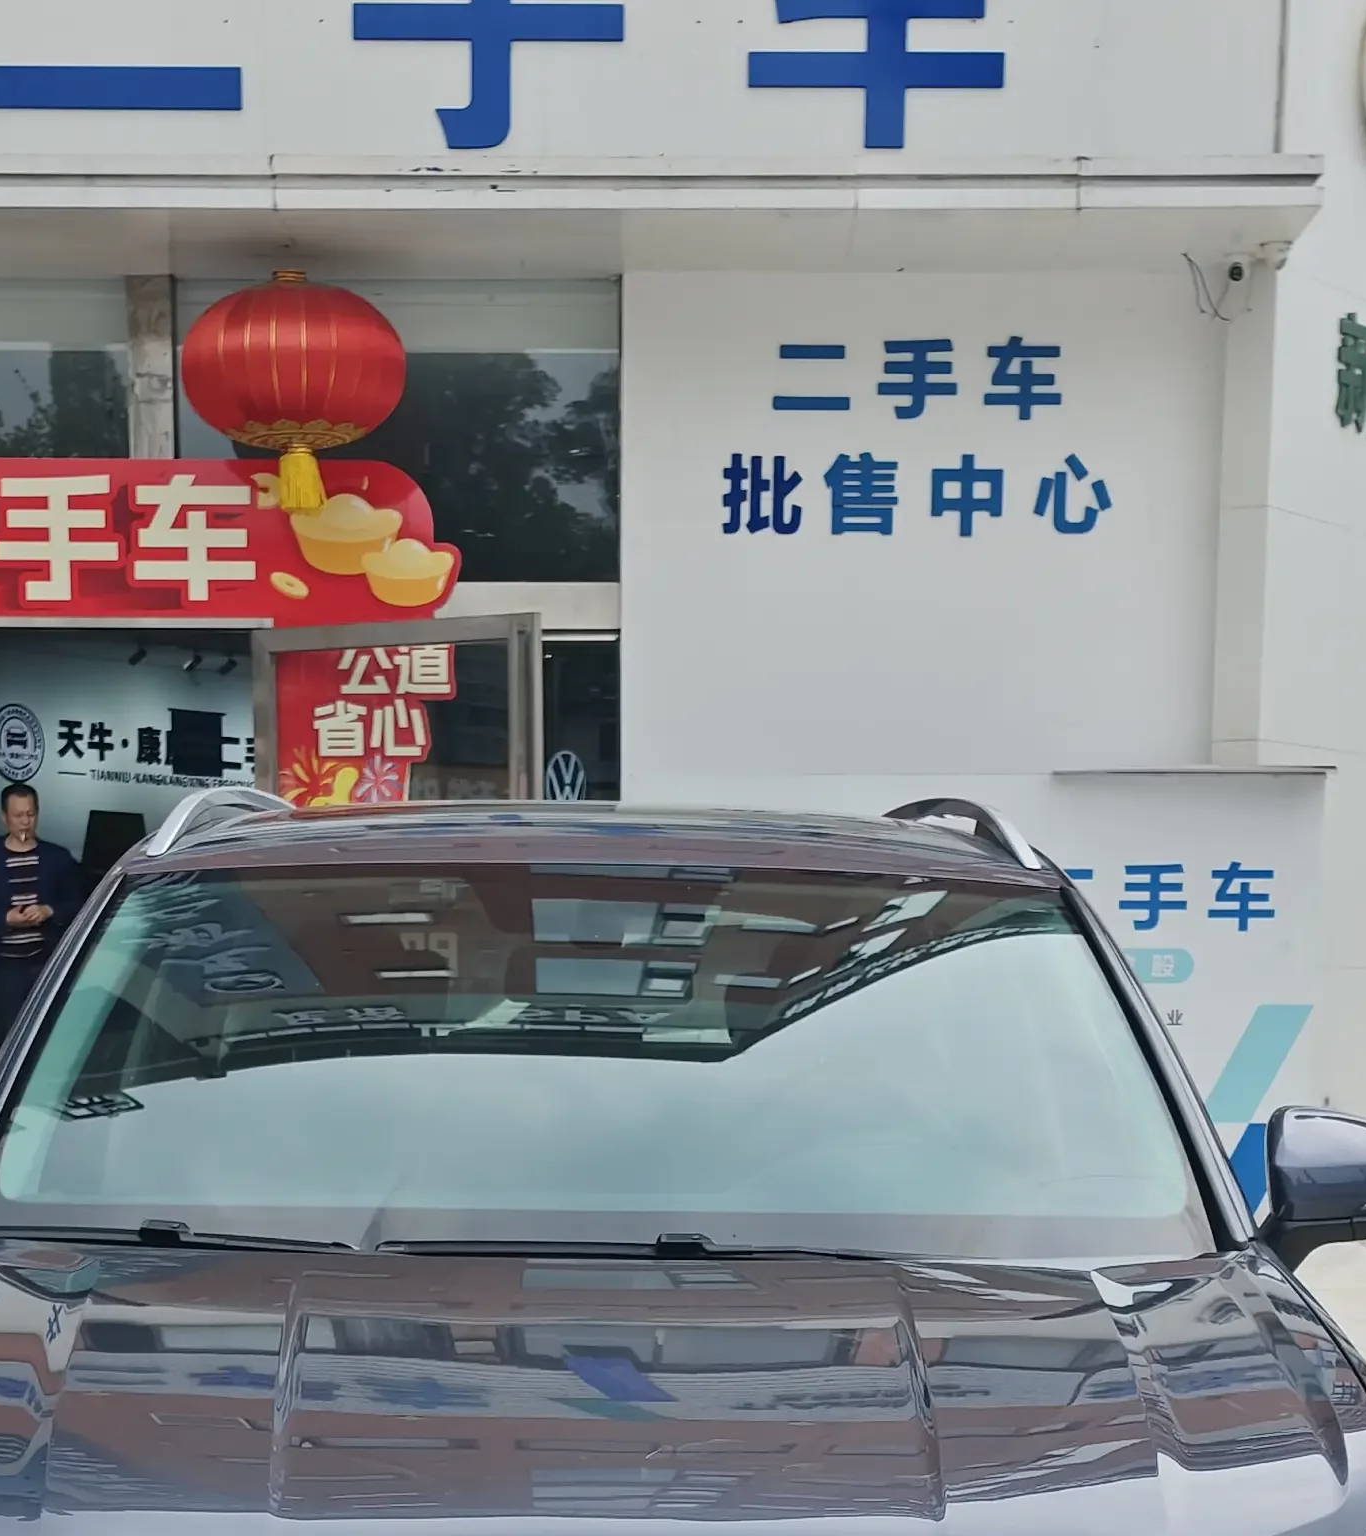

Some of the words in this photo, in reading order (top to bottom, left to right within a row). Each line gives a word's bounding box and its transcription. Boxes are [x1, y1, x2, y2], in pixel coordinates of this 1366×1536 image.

[772, 335, 1063, 421] 二手车
[721, 451, 1113, 538] 批售中心
[337, 644, 452, 695] 公道
[312, 698, 427, 757] 省心
